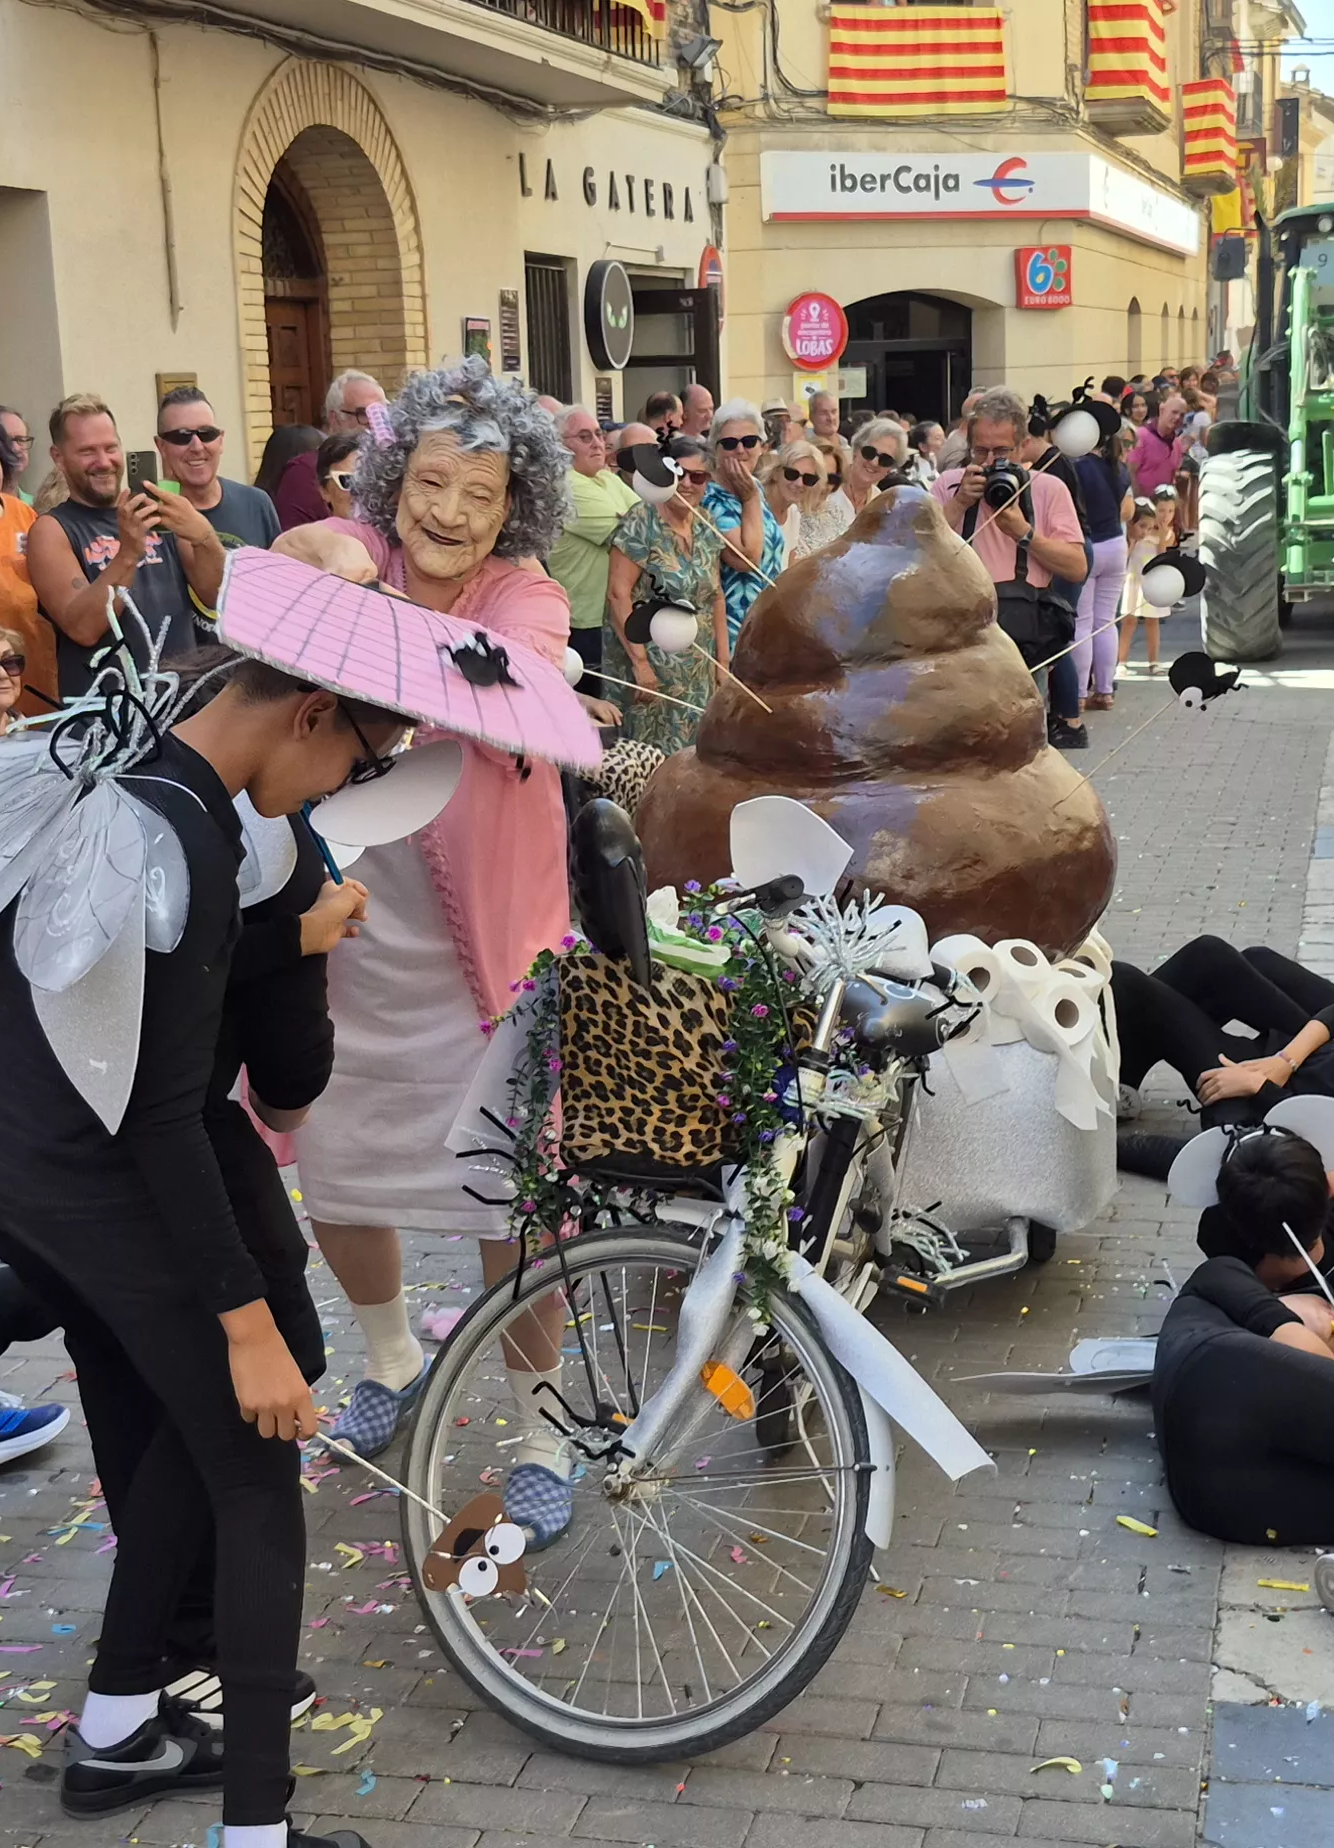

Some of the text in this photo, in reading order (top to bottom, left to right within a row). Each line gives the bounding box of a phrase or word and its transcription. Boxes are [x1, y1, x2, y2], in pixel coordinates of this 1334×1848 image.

[519, 152, 694, 223] LA GATERA
[829, 163, 960, 201] iberCaja
[1026, 251, 1054, 295] 6
[1318, 253, 1328, 267] 9
